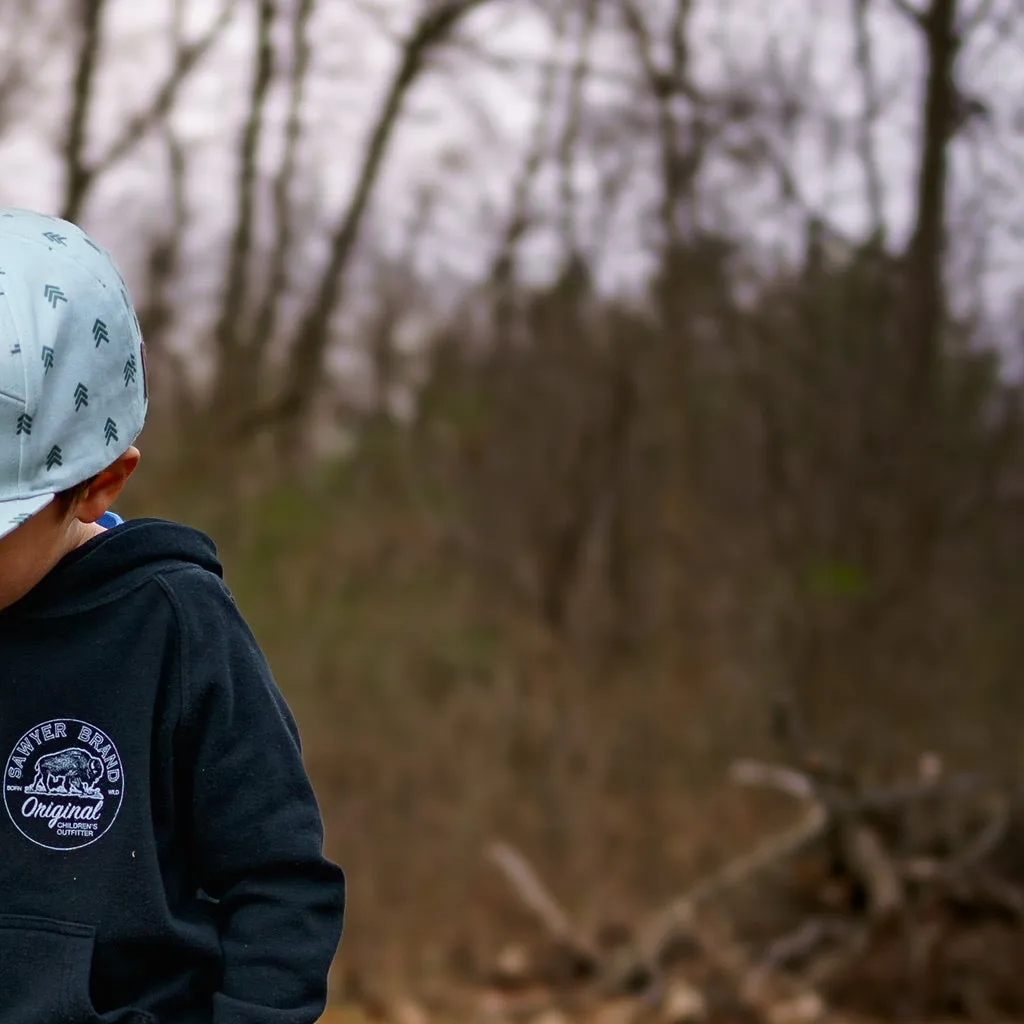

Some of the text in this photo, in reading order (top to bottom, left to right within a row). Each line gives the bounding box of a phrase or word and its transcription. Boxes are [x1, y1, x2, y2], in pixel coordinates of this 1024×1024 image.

[8, 722, 120, 782] SAWYER BRAND
[21, 796, 105, 829] Original
[56, 822, 98, 831] CHILDREN'S
[56, 829, 94, 837] OUTFITTER
